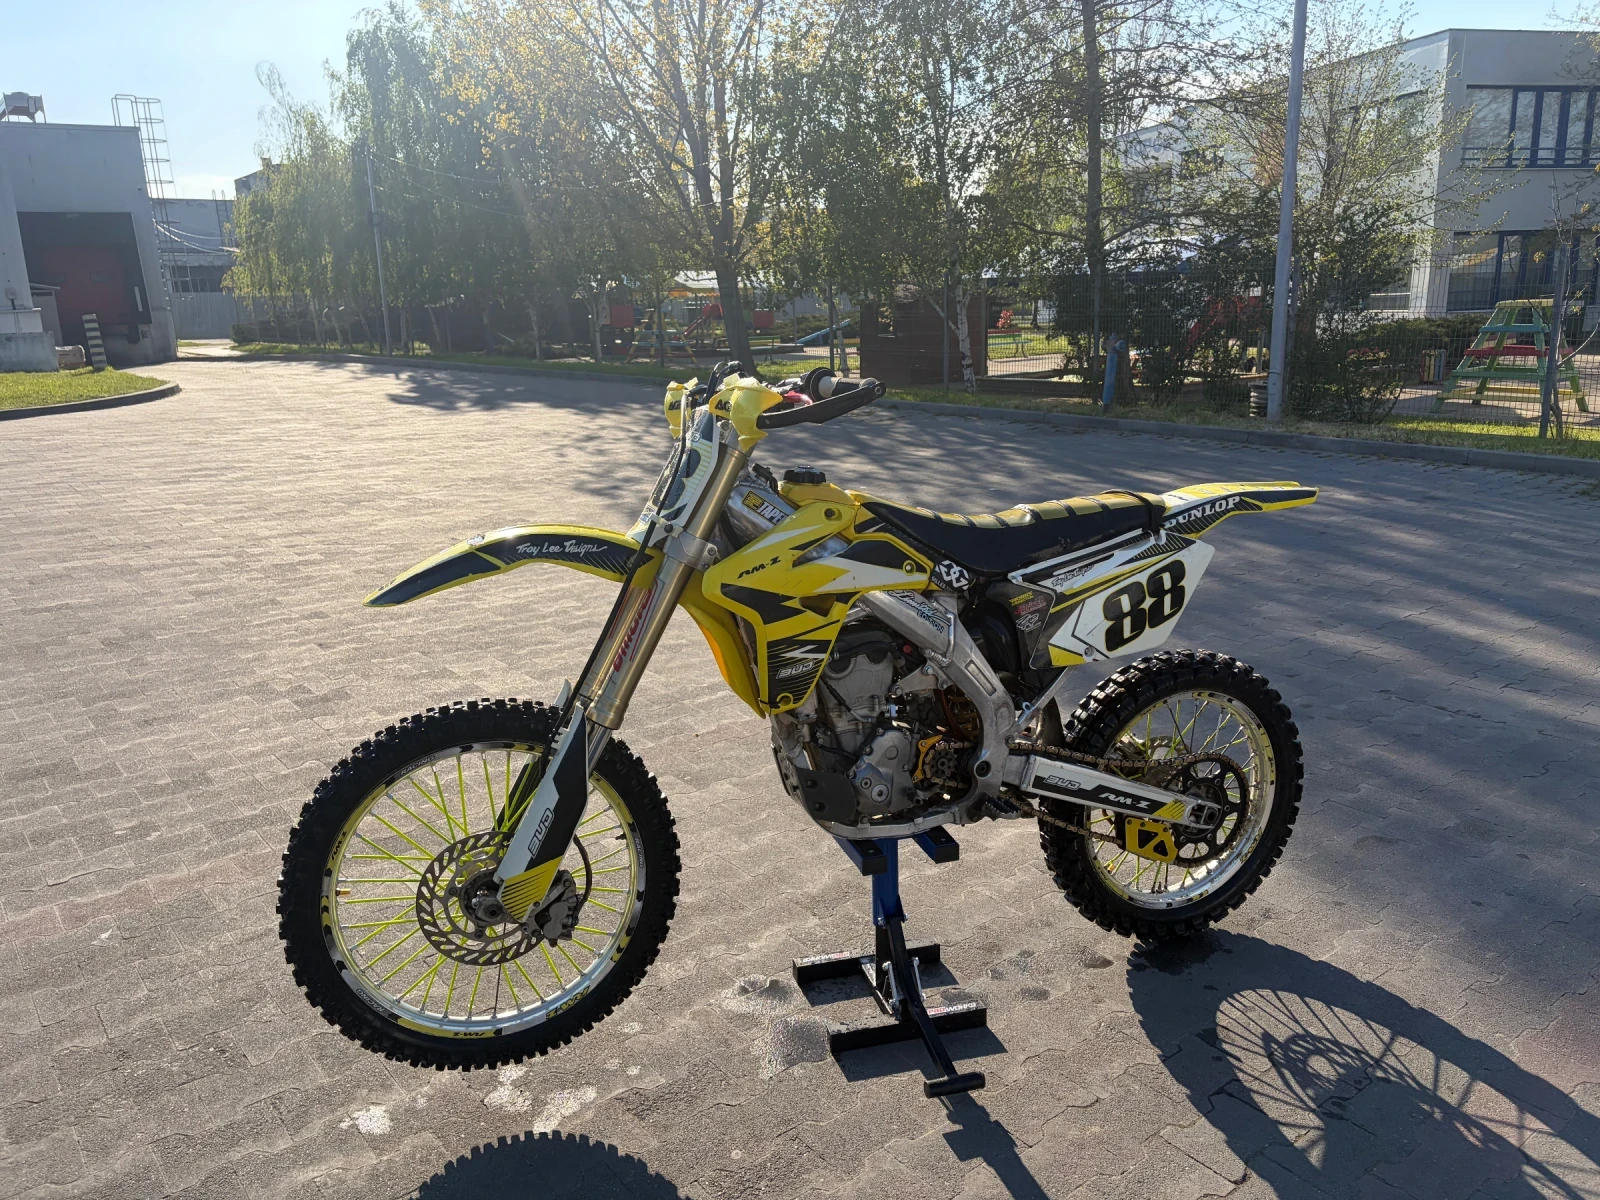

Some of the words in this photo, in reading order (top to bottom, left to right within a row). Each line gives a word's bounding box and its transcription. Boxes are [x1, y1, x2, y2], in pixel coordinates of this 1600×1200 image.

[1163, 495, 1241, 529] DUNLOP
[516, 543, 541, 556] Troy
[542, 542, 563, 553] Lee
[563, 540, 608, 557] Designs
[737, 556, 782, 579] RM-Z
[1102, 559, 1186, 652] 88
[400, 755, 436, 776] RACING
[1098, 792, 1151, 809] RM-Z
[355, 988, 386, 1013] RACING
